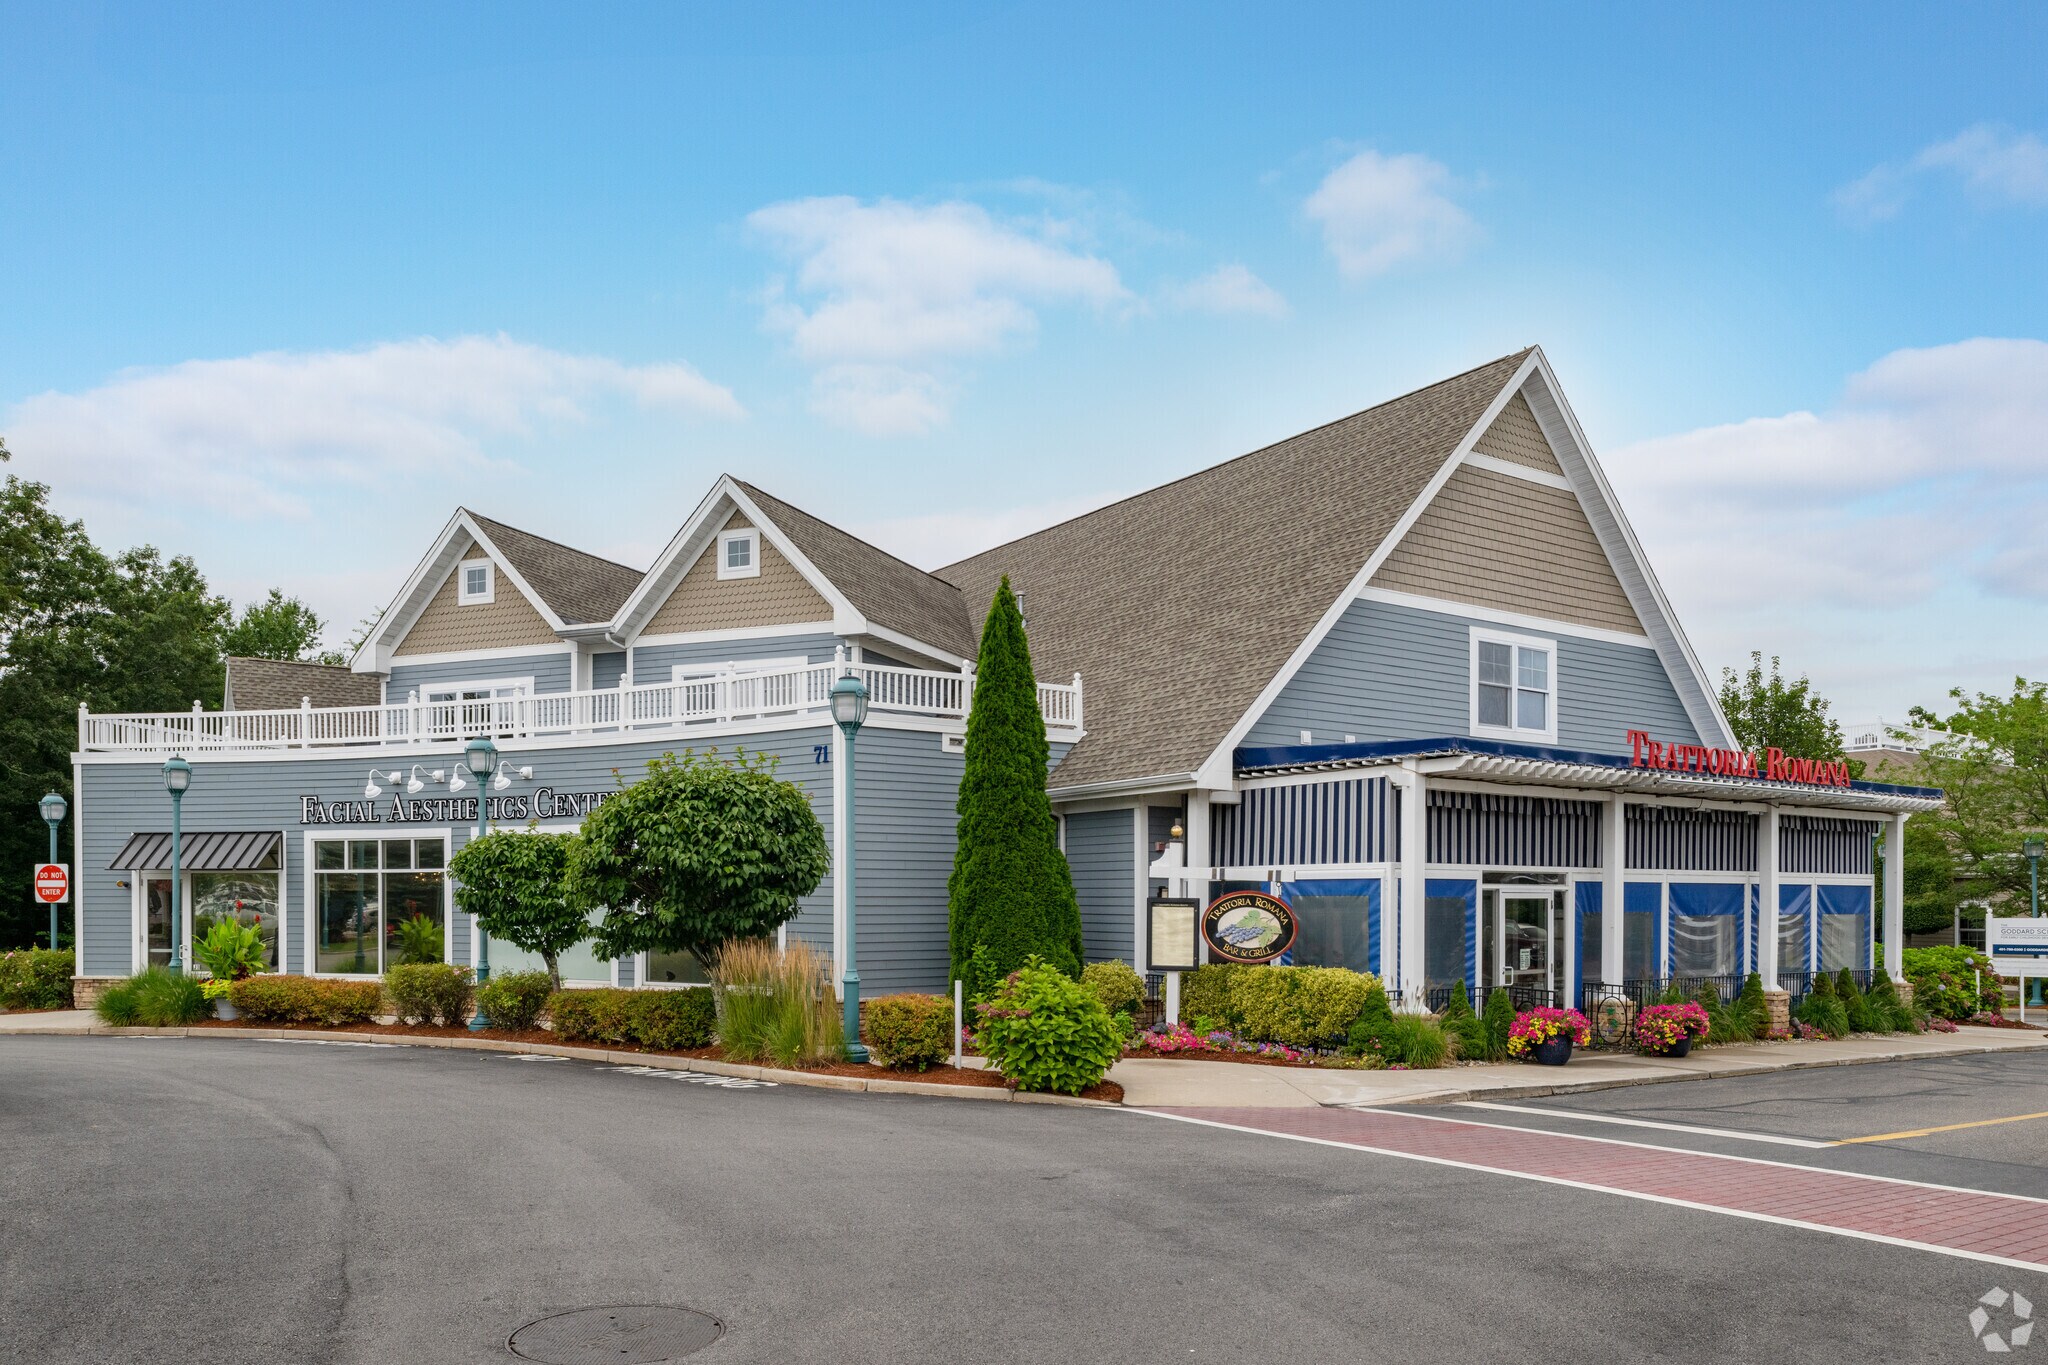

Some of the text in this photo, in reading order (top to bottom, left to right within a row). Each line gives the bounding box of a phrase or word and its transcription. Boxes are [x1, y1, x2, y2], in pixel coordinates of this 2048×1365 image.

[814, 745, 829, 764] 71
[1627, 729, 1852, 788] TRATTORIA ROMANA
[300, 795, 381, 824] FACIAL
[533, 787, 620, 819] CENTE
[1208, 897, 1289, 926] TRATTORIA ROMANA
[1222, 943, 1274, 958] BAR & GRILL
